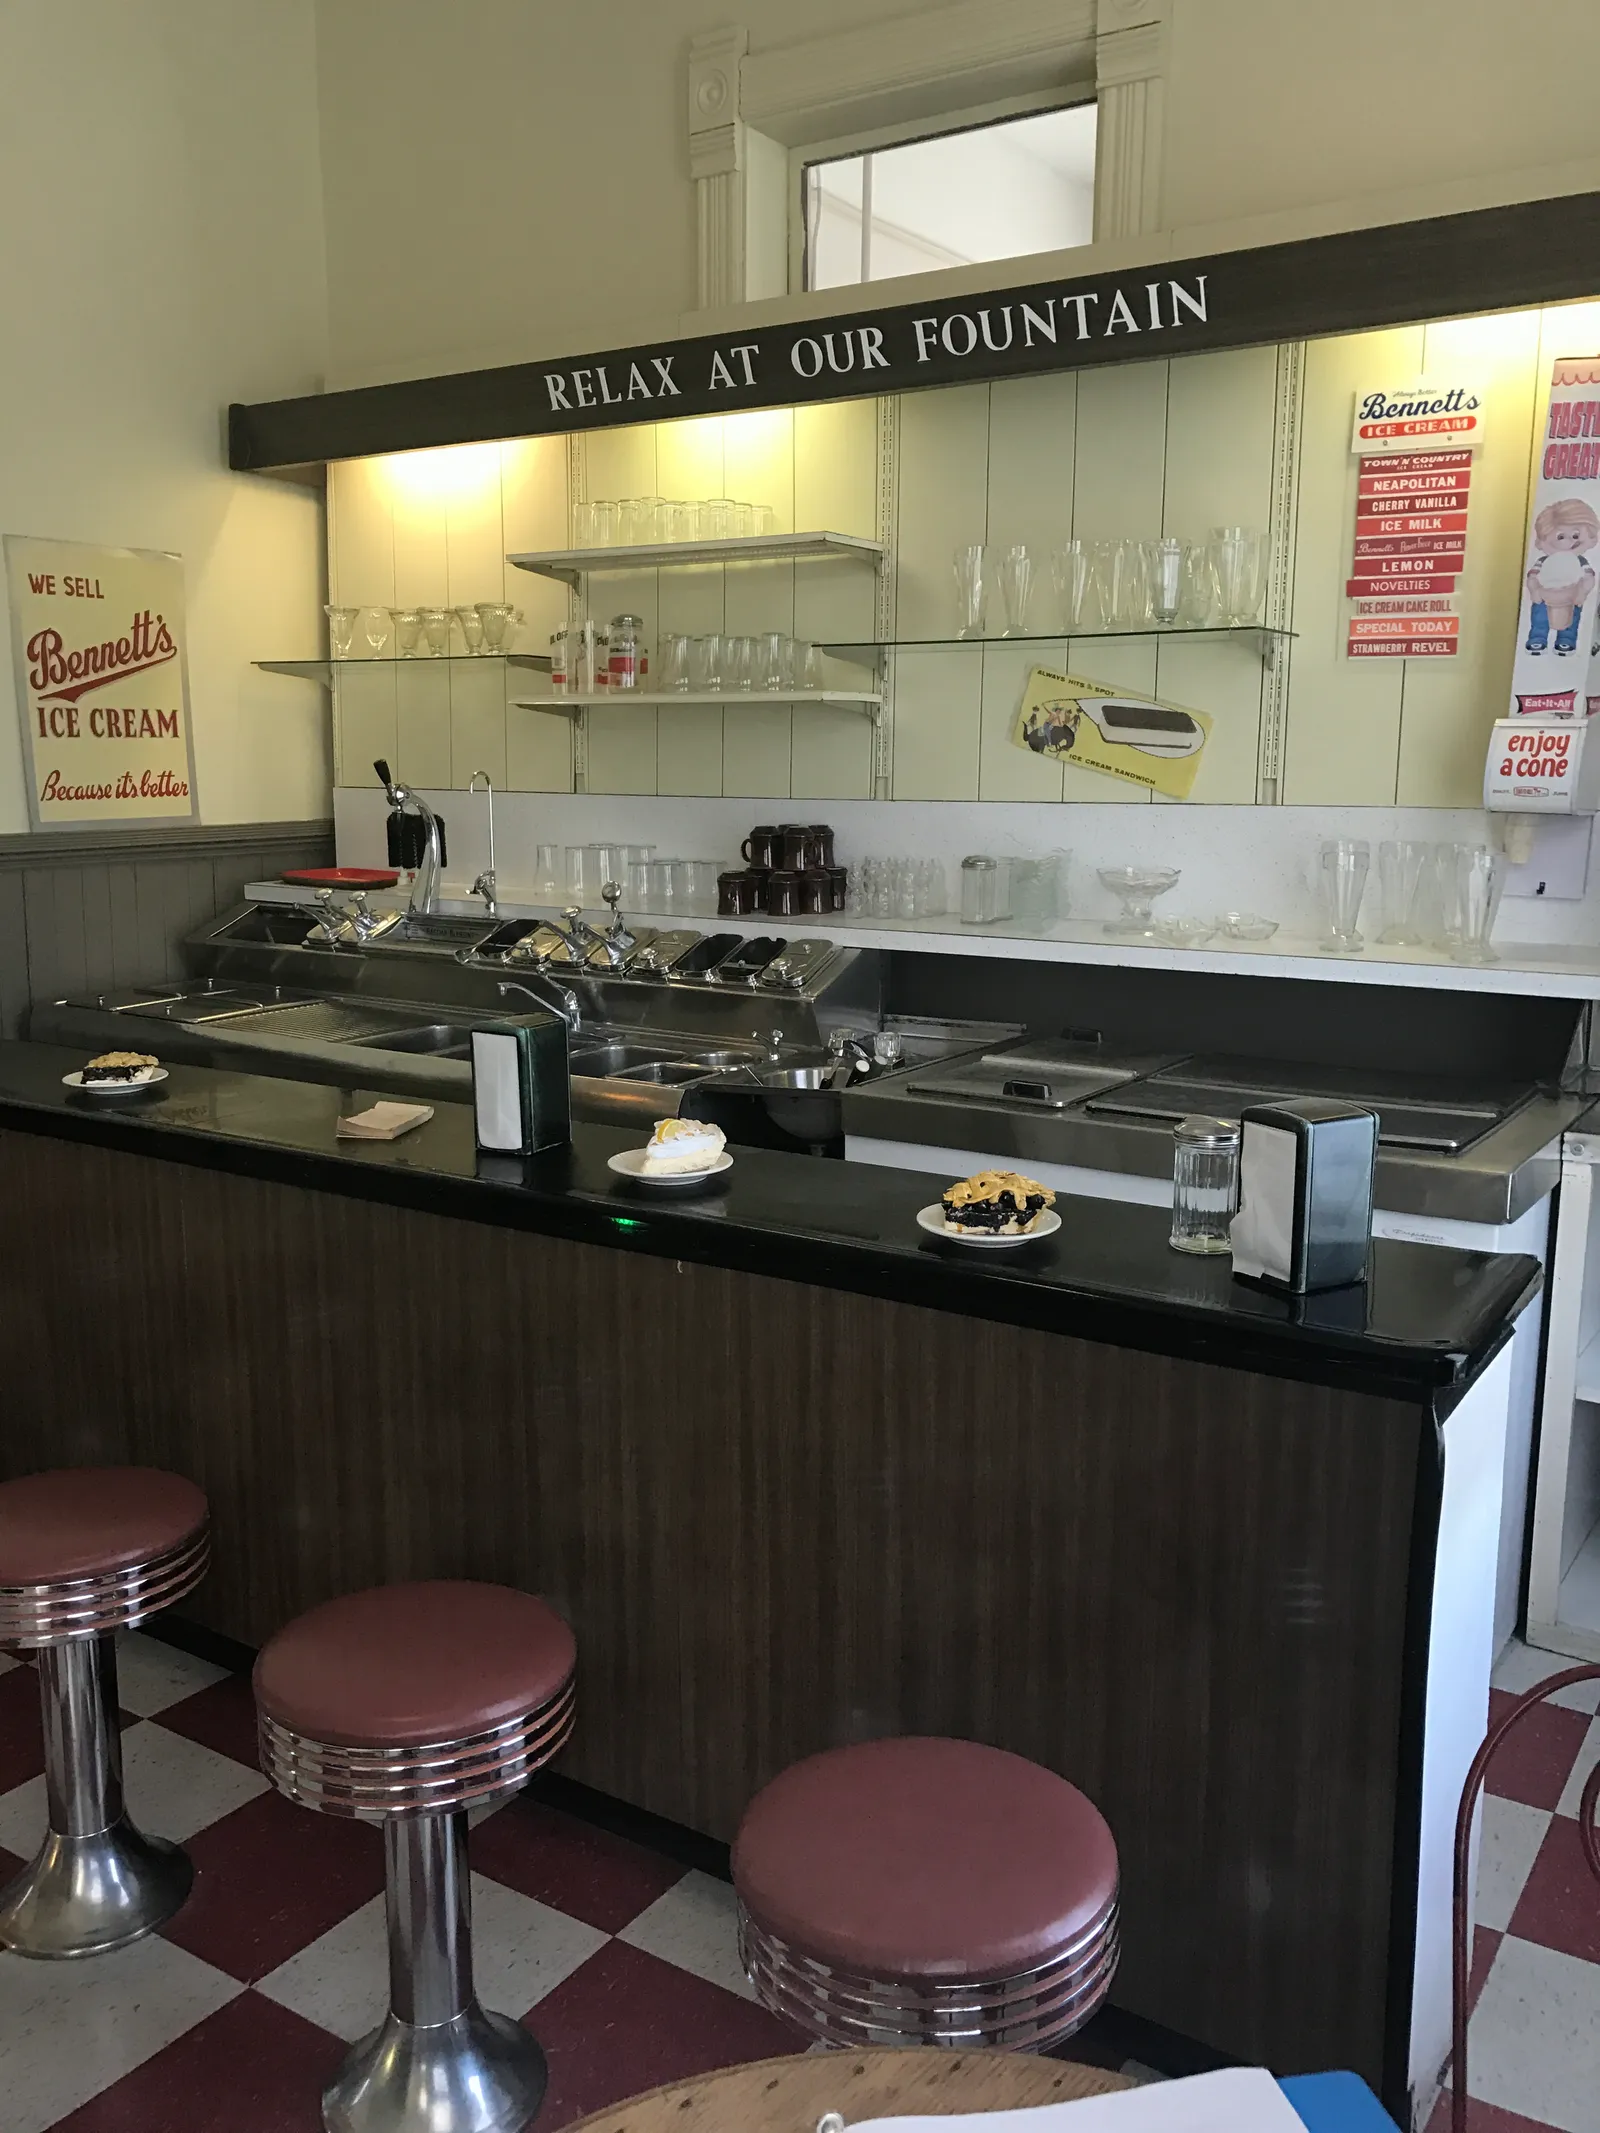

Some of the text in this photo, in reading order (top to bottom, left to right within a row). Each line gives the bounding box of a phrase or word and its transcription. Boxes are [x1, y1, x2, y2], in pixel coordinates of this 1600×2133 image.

[543, 275, 1209, 412] RELAX AT OUR FOUNTAIN
[1367, 418, 1469, 437] ICE CREAM
[1363, 459, 1399, 468] TOWN
[1412, 453, 1469, 464] COUNTRY
[1373, 476, 1457, 491] NEAPOLITAN
[1372, 496, 1457, 512] CHERRY VANILLA
[1380, 518, 1442, 531] ICE MILK
[1433, 541, 1443, 550] ICE
[1382, 560, 1434, 572] LEMON
[28, 573, 105, 599] WE SELL
[1370, 580, 1431, 592] NOVELTIES
[1359, 600, 1452, 614] ICE CREAM CAKE ROLL
[1356, 621, 1453, 634] SPECIAL TODAY
[26, 609, 178, 691] Bennett's
[1353, 642, 1451, 654] STRAWBERRY REVEL
[1037, 669, 1066, 683] ALWAYS
[1068, 679, 1085, 689] HITS
[1095, 686, 1115, 697] SPOT
[36, 707, 180, 738] ICE CREAM
[1508, 730, 1571, 757] enjoy
[1069, 753, 1156, 785] ICE CREAM SANDWICH
[1500, 758, 1569, 777] a cone
[40, 769, 189, 802] Because it's better
